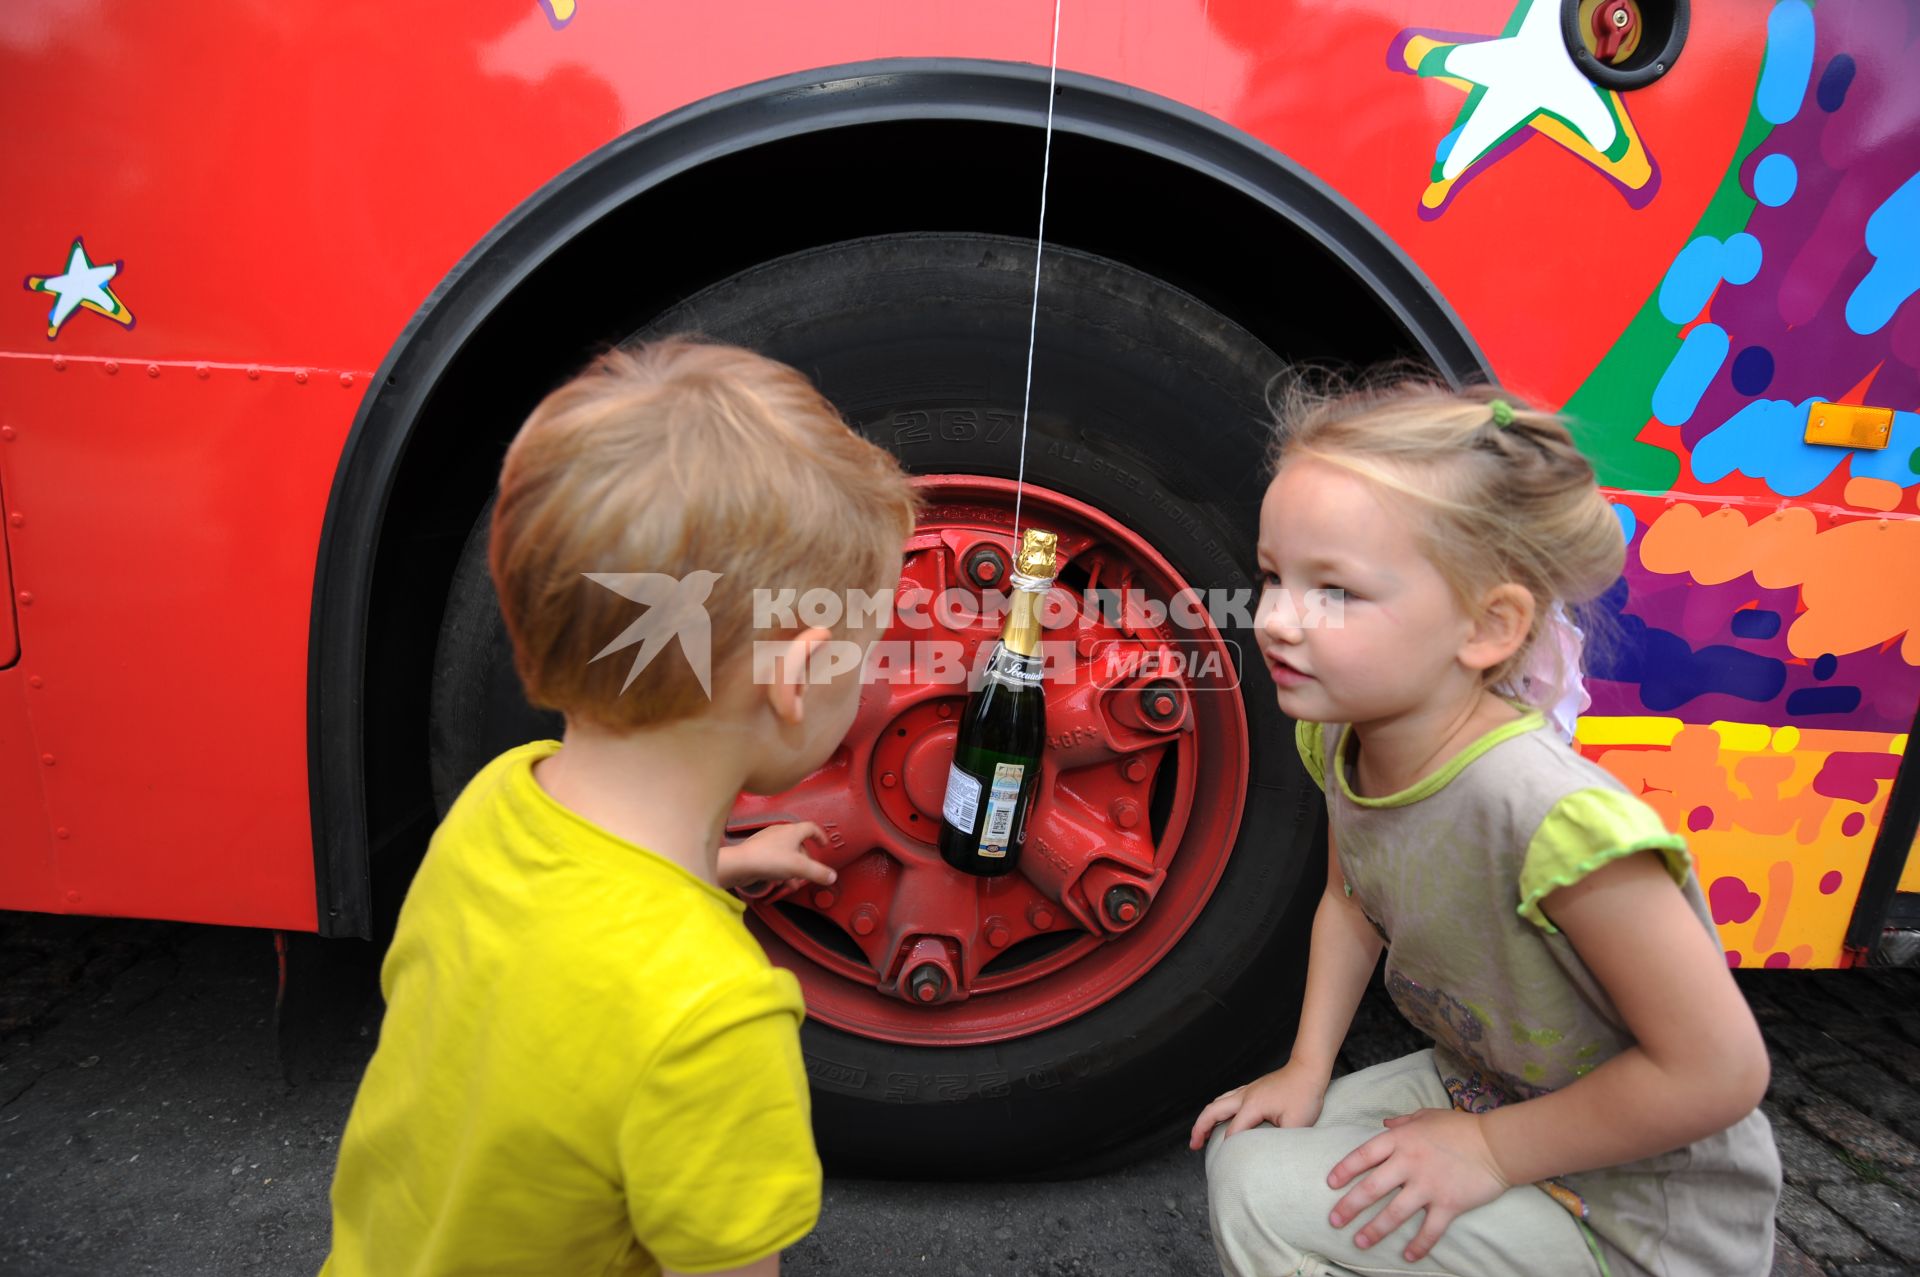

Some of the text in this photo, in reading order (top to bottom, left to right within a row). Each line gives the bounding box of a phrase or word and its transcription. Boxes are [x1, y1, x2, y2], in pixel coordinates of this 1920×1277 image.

[1047, 439, 1085, 466] ALL
[1090, 457, 1146, 496] STEEL
[1147, 489, 1204, 544] RADIAL
